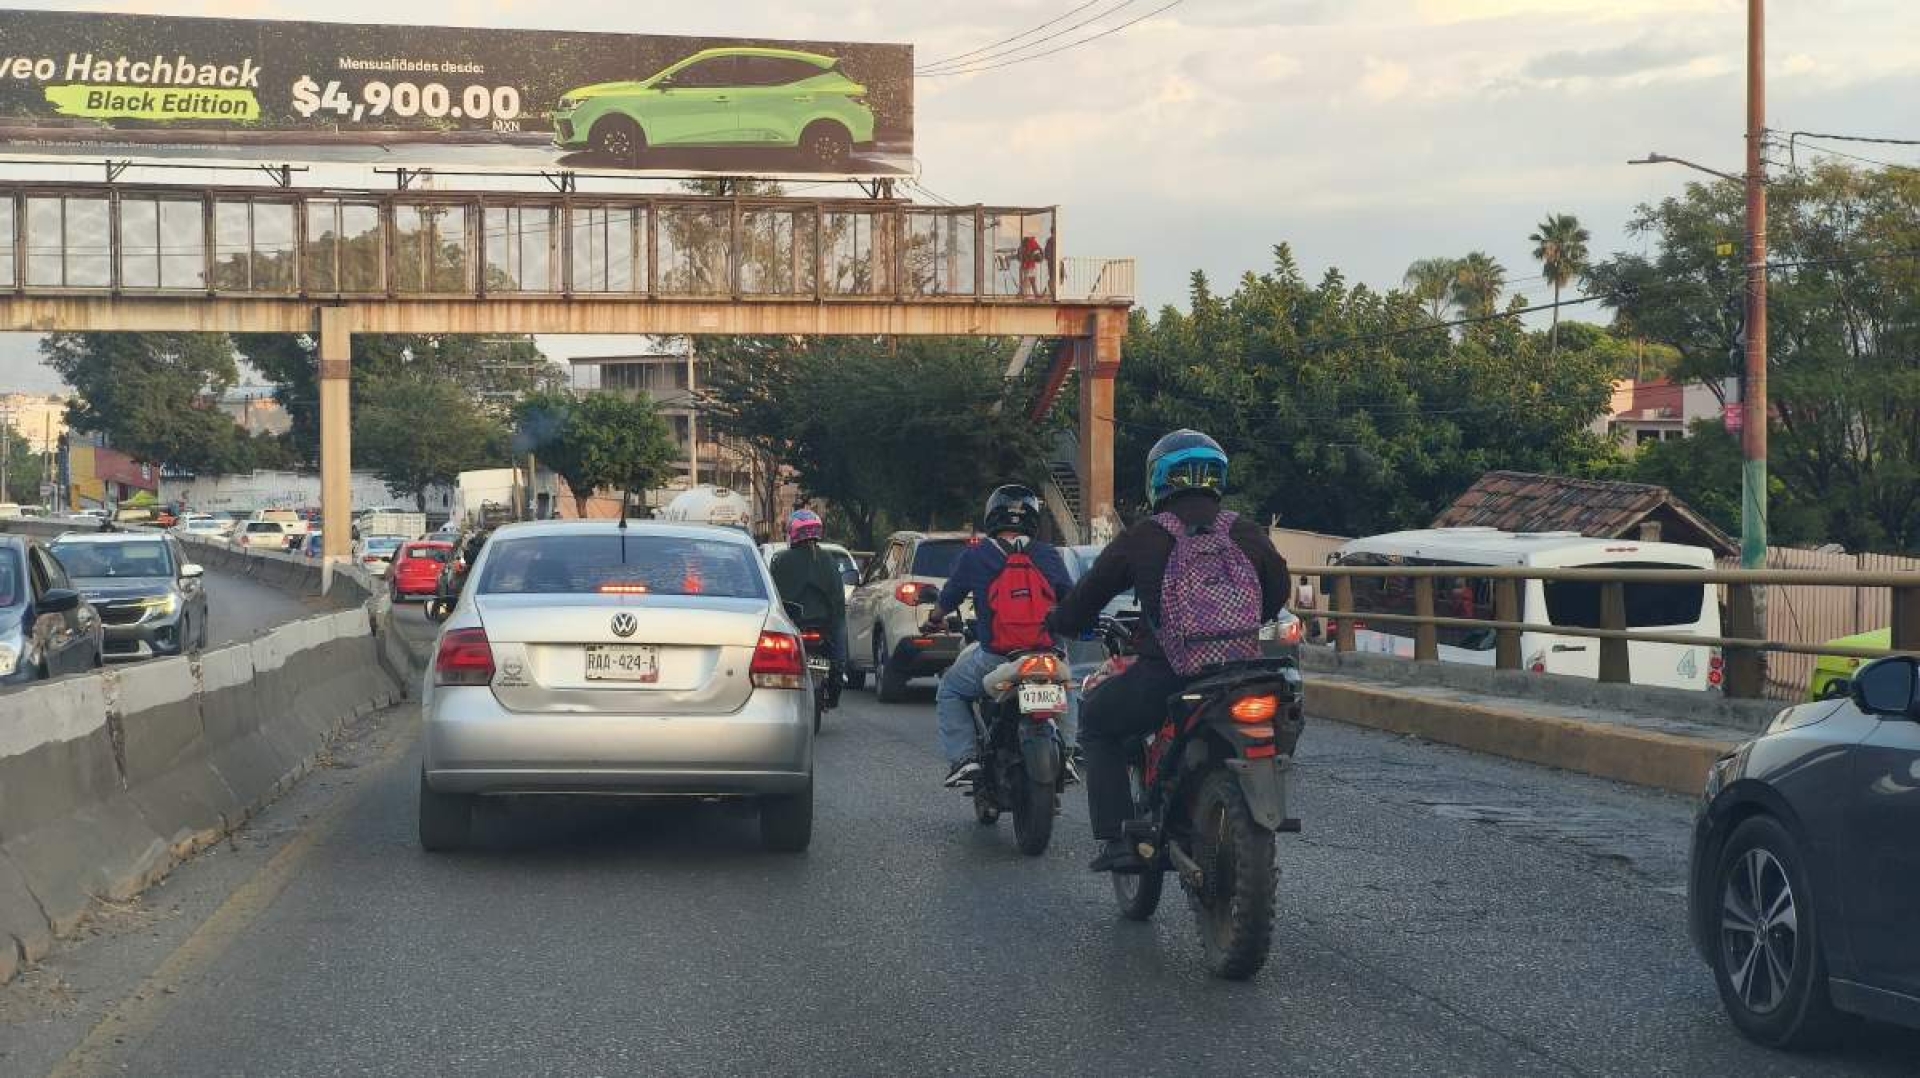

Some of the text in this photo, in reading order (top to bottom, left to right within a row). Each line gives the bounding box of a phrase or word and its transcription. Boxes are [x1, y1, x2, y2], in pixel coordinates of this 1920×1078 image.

[65, 53, 262, 88] Hatchback
[339, 58, 484, 73] Mensualidades desde:
[87, 91, 248, 115] Black Edition
[492, 121, 520, 132] MXN
[1677, 650, 1696, 678] 4
